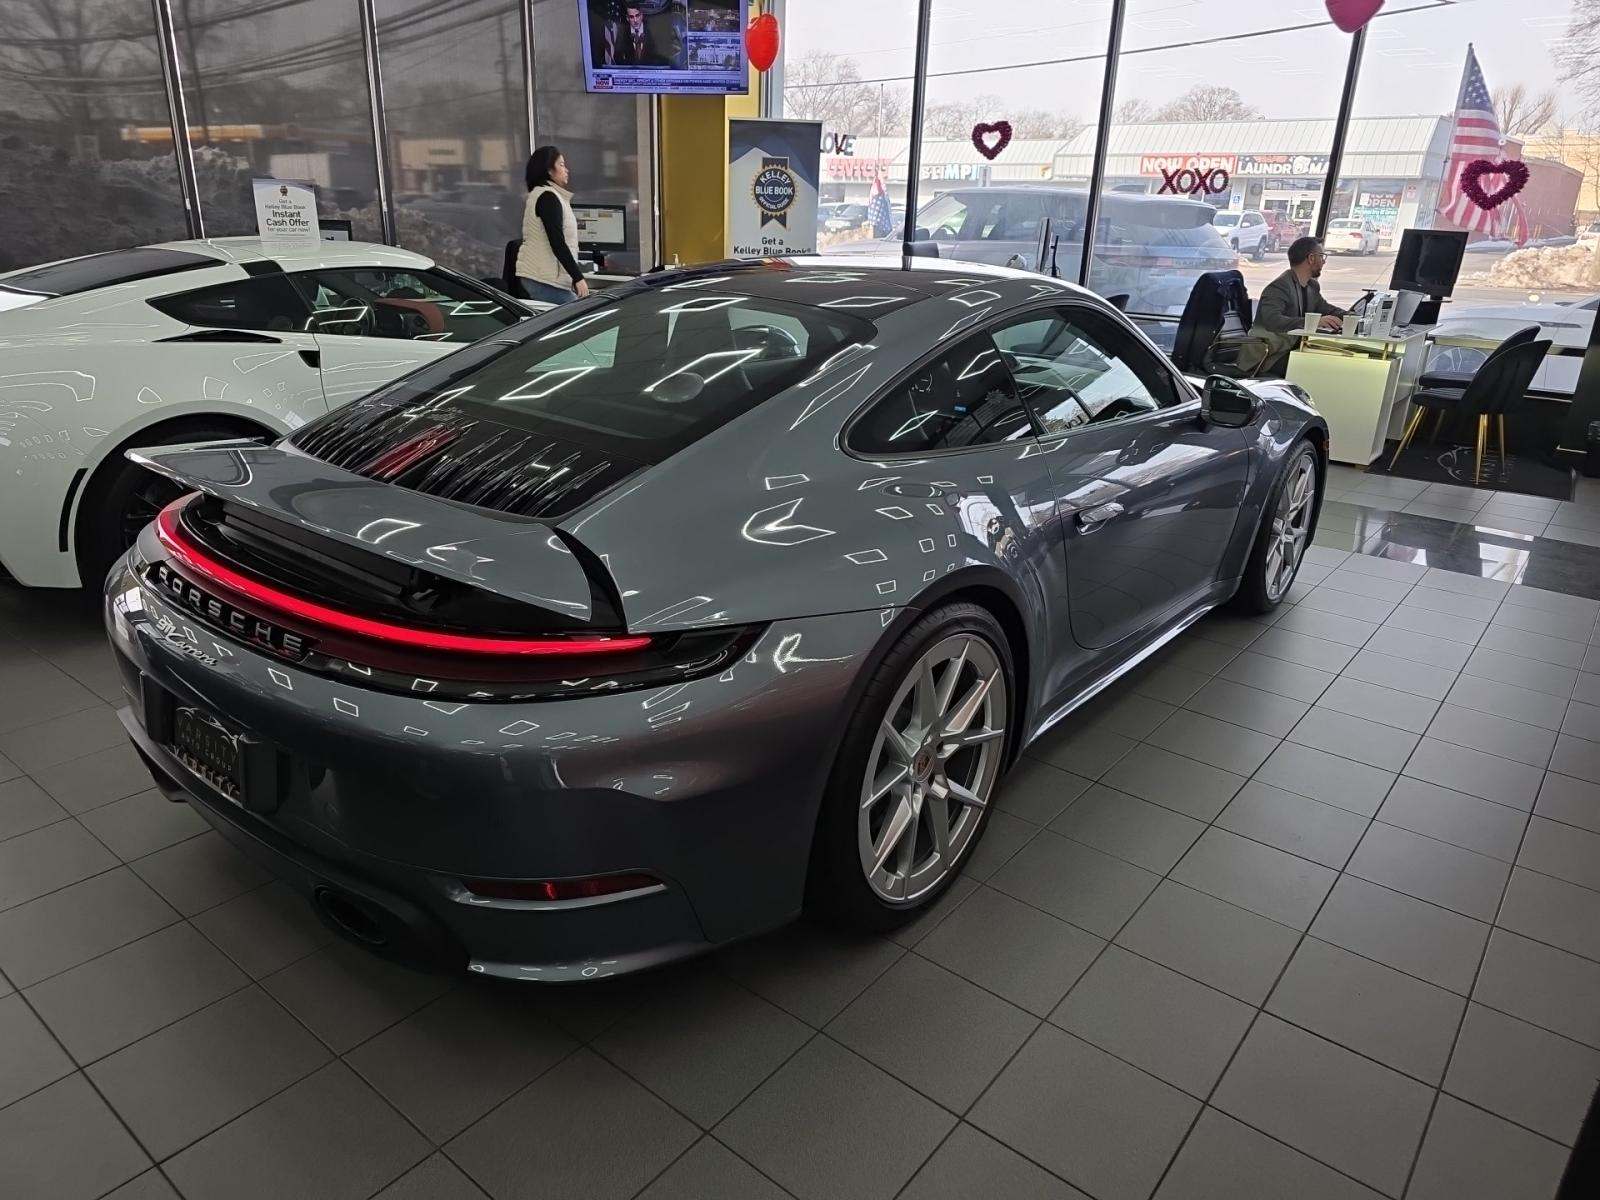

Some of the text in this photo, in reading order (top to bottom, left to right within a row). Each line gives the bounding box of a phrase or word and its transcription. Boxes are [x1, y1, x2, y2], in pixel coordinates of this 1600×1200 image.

[1142, 156, 1182, 173] NOW
[1186, 156, 1234, 174] OPEN
[760, 170, 791, 185] KELLEY
[1157, 167, 1230, 195] XOXO
[755, 186, 793, 195] BLUE BOOK
[272, 210, 301, 218] Instant
[266, 218, 310, 227] Cash Offer
[761, 236, 785, 246] Get a
[733, 246, 761, 256] Kelley
[763, 247, 783, 255] Blue
[158, 566, 303, 650] PORSCHE
[164, 631, 218, 666] Carrera
